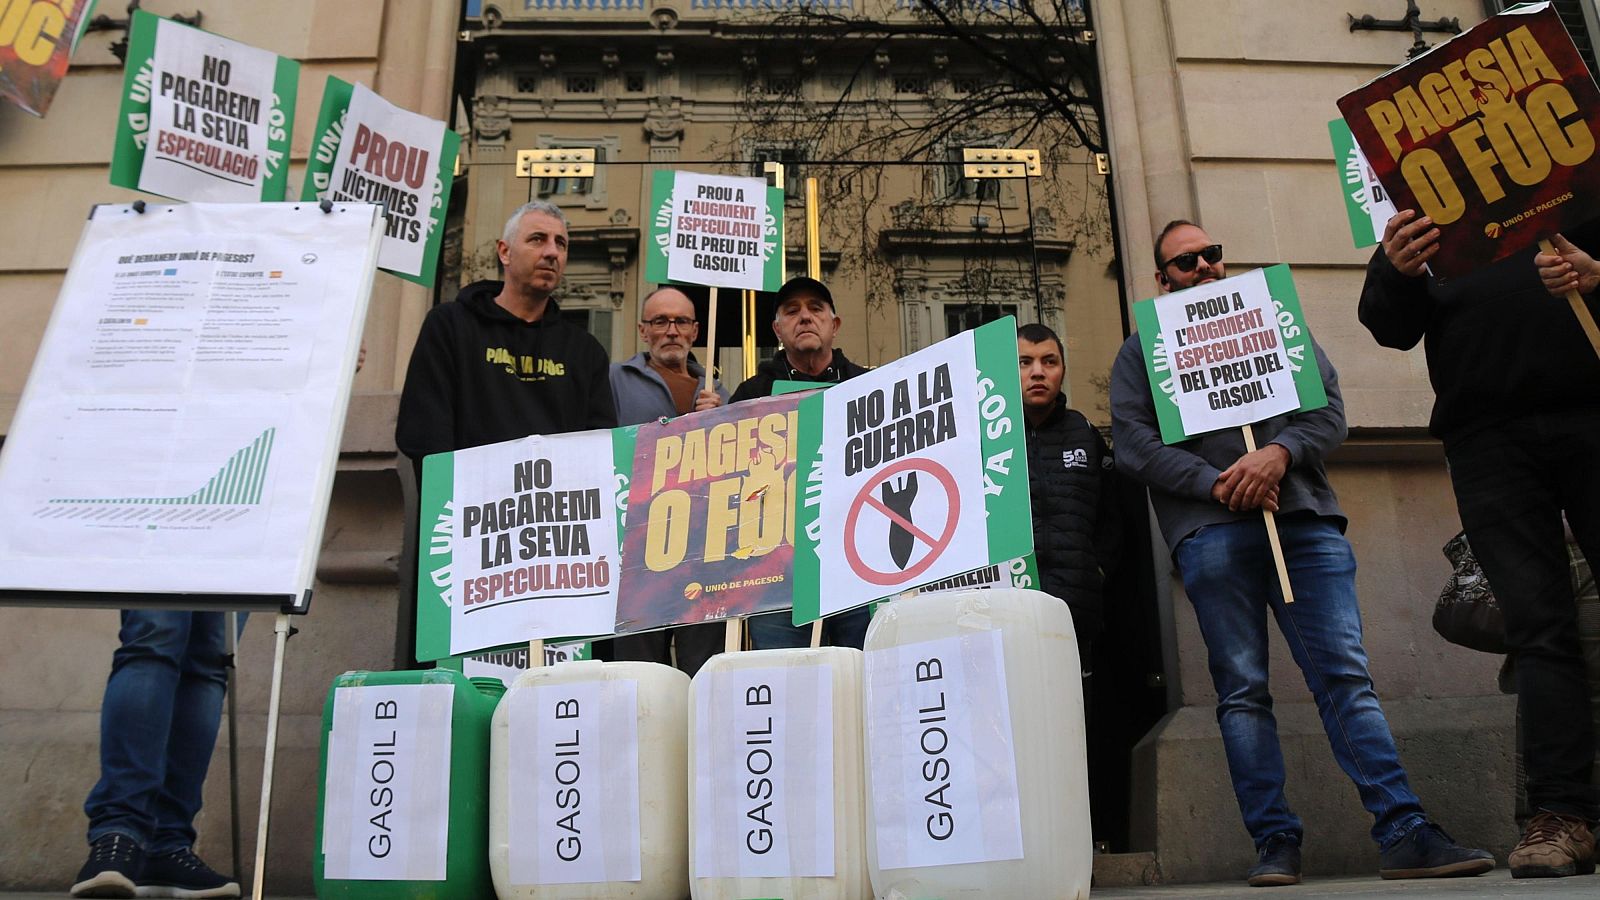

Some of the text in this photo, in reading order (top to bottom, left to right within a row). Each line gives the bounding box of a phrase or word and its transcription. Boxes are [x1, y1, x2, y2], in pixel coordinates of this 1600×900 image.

[202, 54, 231, 86] NO
[1365, 24, 1564, 163] PAGESIA
[160, 71, 260, 125] PAGAREM
[173, 103, 249, 150] LA SEVA
[157, 130, 259, 180] ESPECULACIÓ
[349, 123, 429, 190] PROU
[1400, 83, 1596, 225] O FOC
[342, 167, 419, 217] VÍCTIMES
[684, 200, 757, 221] L'AUGMENT
[697, 185, 744, 203] PROU A
[1502, 191, 1574, 229] UNIÓ DE PAGESOS
[676, 233, 759, 257] DEL PREU DEL
[677, 216, 760, 239] ESPECULATIU
[200, 252, 210, 260] DE
[1175, 307, 1265, 347] L'AUGMENT
[1185, 291, 1245, 323] PROU A
[1174, 329, 1278, 370] ESPECULATIU
[1179, 352, 1284, 394] DEL PREU DEL
[846, 362, 953, 437] NO A LA
[651, 410, 798, 496] PAGESI
[844, 400, 957, 477] GUERRA
[513, 458, 552, 493] NO
[463, 487, 601, 538] PAGAREM
[644, 489, 691, 572] O
[703, 462, 797, 564] FO
[481, 523, 591, 570] LA SEVA
[463, 555, 610, 606] ESPECULACIÓ
[705, 574, 784, 593] UNIÓ DE PAGESOS
[746, 684, 774, 855] GASOIL B
[916, 658, 954, 841] GASOIL B
[368, 700, 398, 858] GASOIL B
[555, 698, 582, 862] GASOIL B
